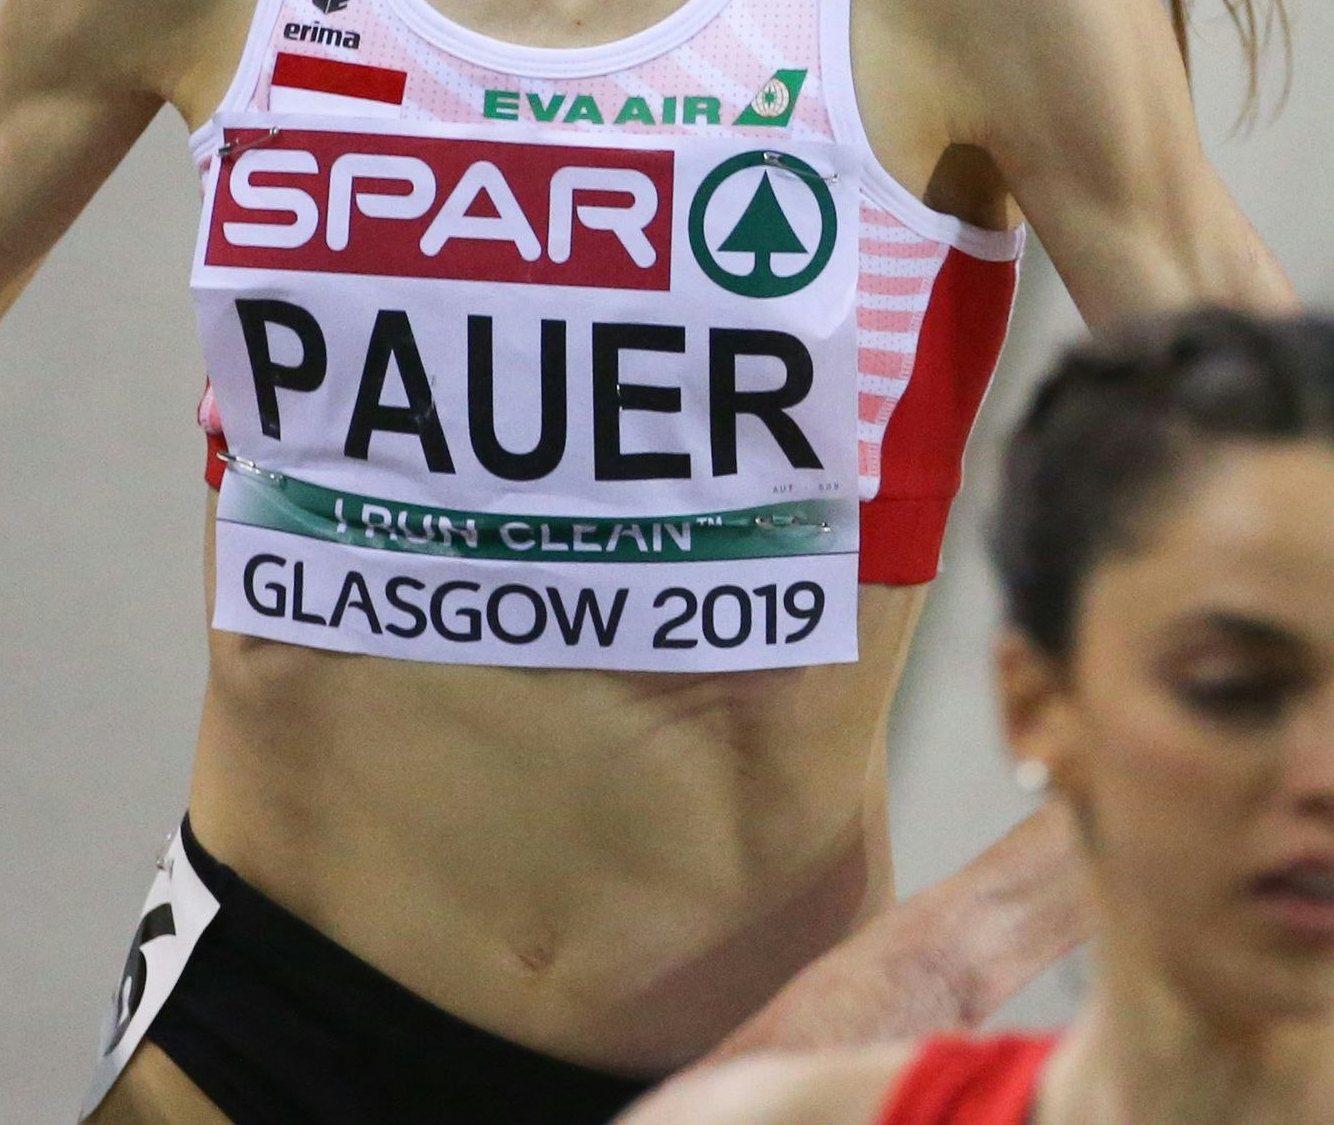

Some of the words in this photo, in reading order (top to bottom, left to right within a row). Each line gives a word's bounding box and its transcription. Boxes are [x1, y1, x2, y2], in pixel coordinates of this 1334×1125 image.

[283, 21, 361, 50] erima
[483, 89, 605, 125] EVA
[613, 96, 721, 125] AIR
[223, 151, 657, 267] SPAR
[235, 298, 824, 479] PAUER
[334, 498, 347, 533] I
[361, 503, 478, 548] RUN
[243, 554, 629, 645] GLASGOW
[652, 579, 825, 649] 2019
